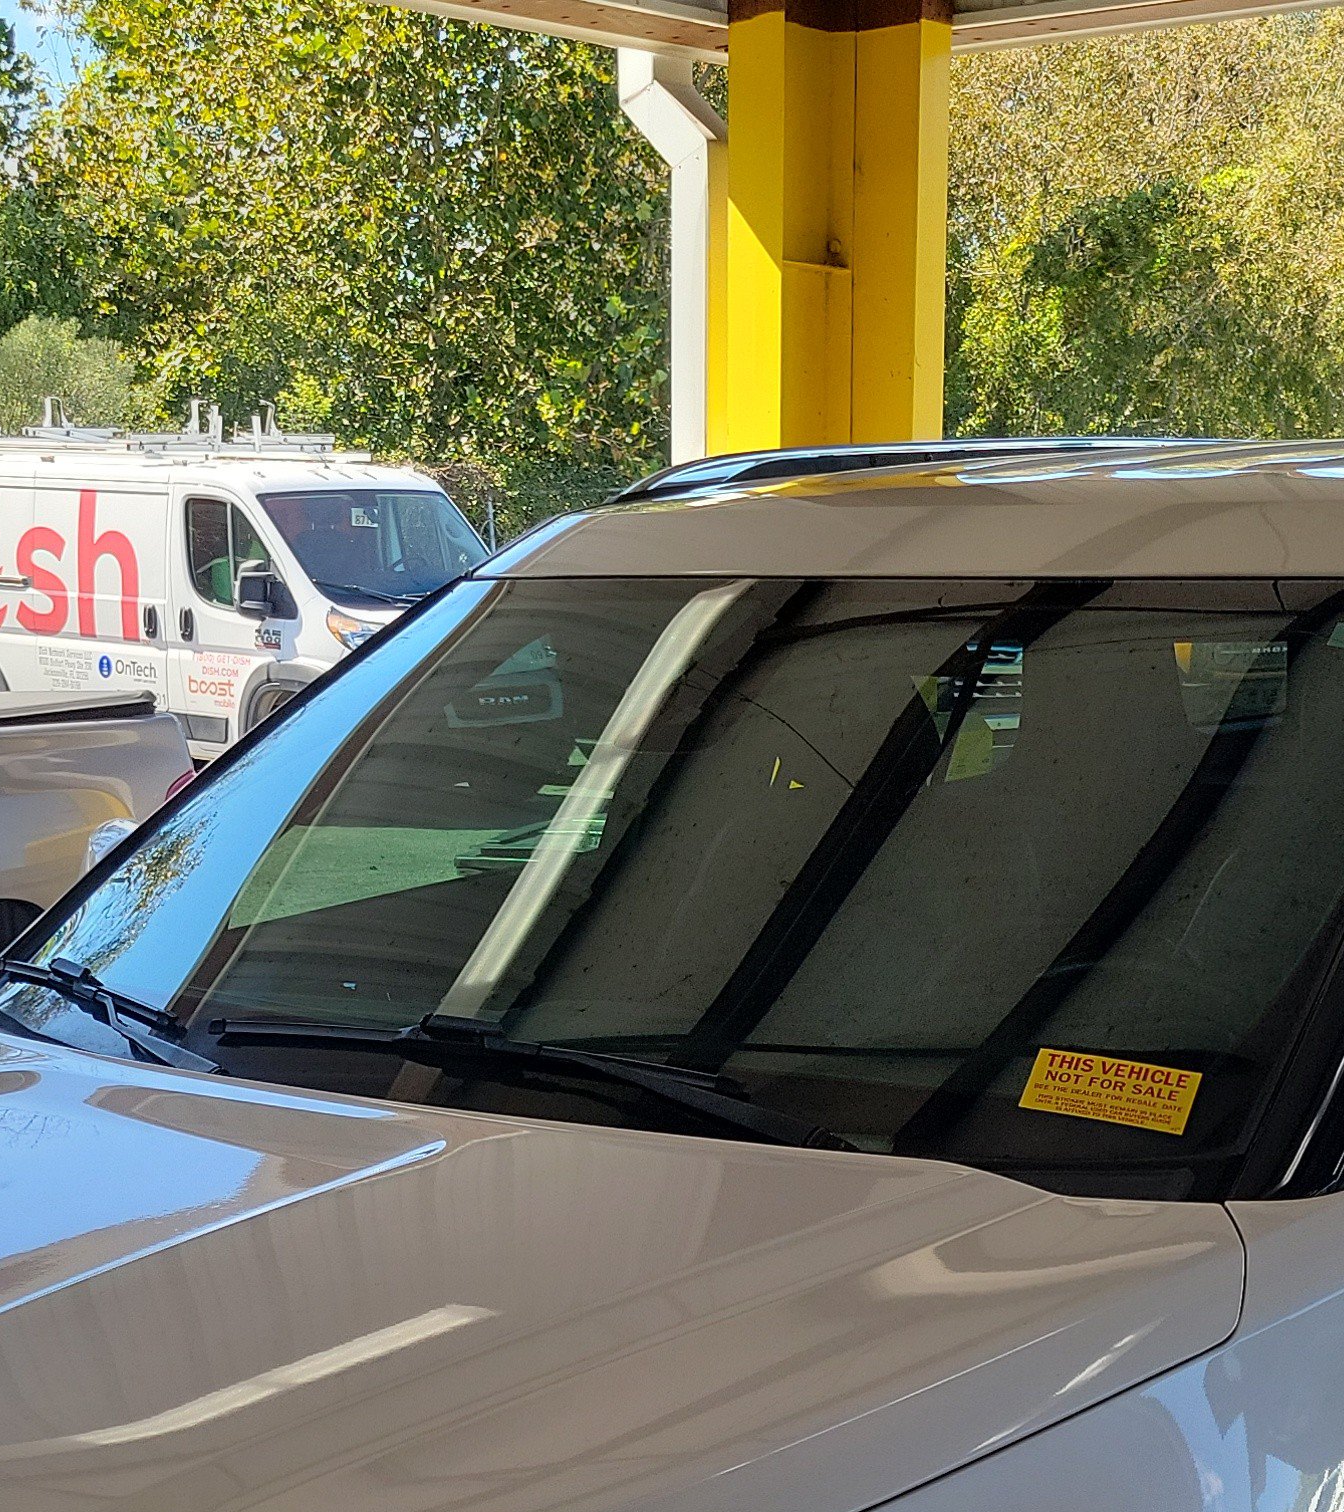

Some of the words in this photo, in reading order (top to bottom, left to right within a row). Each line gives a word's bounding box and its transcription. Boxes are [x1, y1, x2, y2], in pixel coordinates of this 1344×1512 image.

[116, 659, 157, 679] OnTech
[202, 666, 239, 678] DISH.COM
[188, 675, 235, 697] boost
[1048, 1054, 1094, 1072] THIS
[1102, 1061, 1190, 1089] VEHICLE
[1045, 1070, 1083, 1085] NOT
[1088, 1077, 1126, 1092] FOR
[1132, 1084, 1180, 1101] SALE
[1071, 1089, 1102, 1098] DEALER
[1126, 1097, 1158, 1107] RESALE
[1163, 1104, 1183, 1112] DATE
